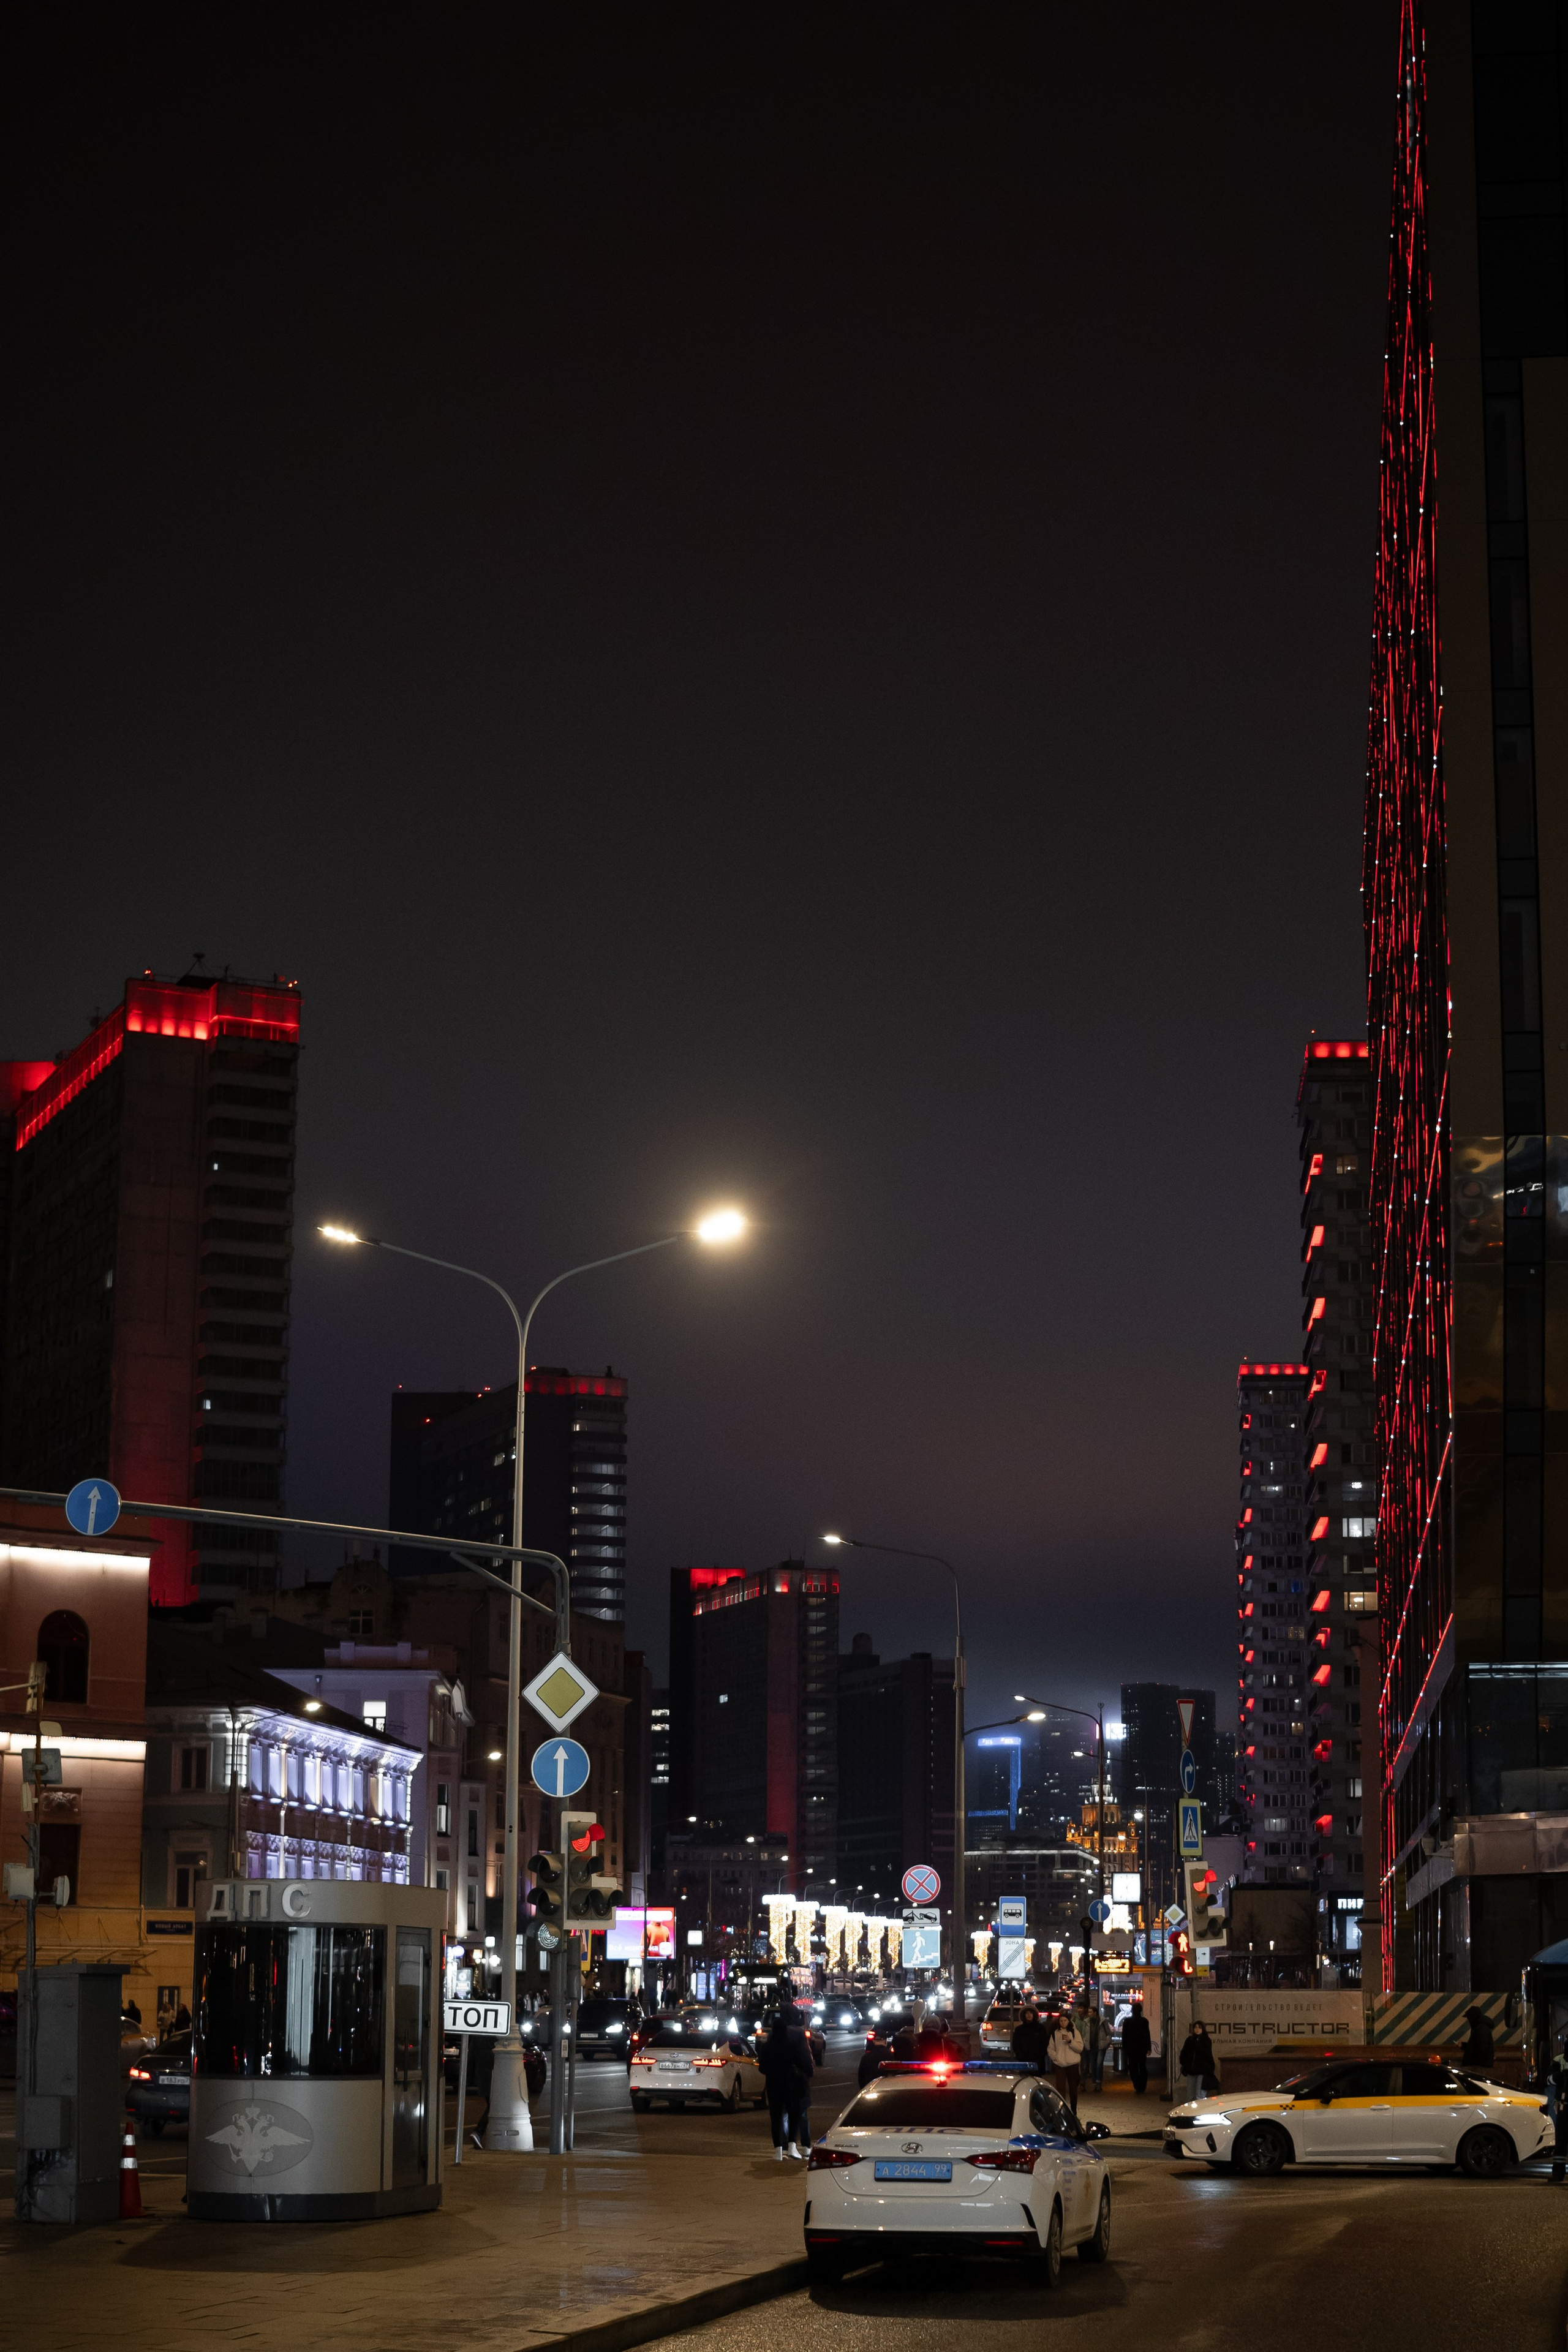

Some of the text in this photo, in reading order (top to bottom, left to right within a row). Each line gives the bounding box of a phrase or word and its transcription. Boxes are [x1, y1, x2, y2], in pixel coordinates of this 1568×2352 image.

[206, 1883, 311, 1921] ДПС
[448, 2006, 499, 2029] ТОП
[1189, 2023, 1349, 2035] ONSTRUCTOR
[895, 2164, 926, 2176] 2844
[935, 2164, 946, 2173] 99
